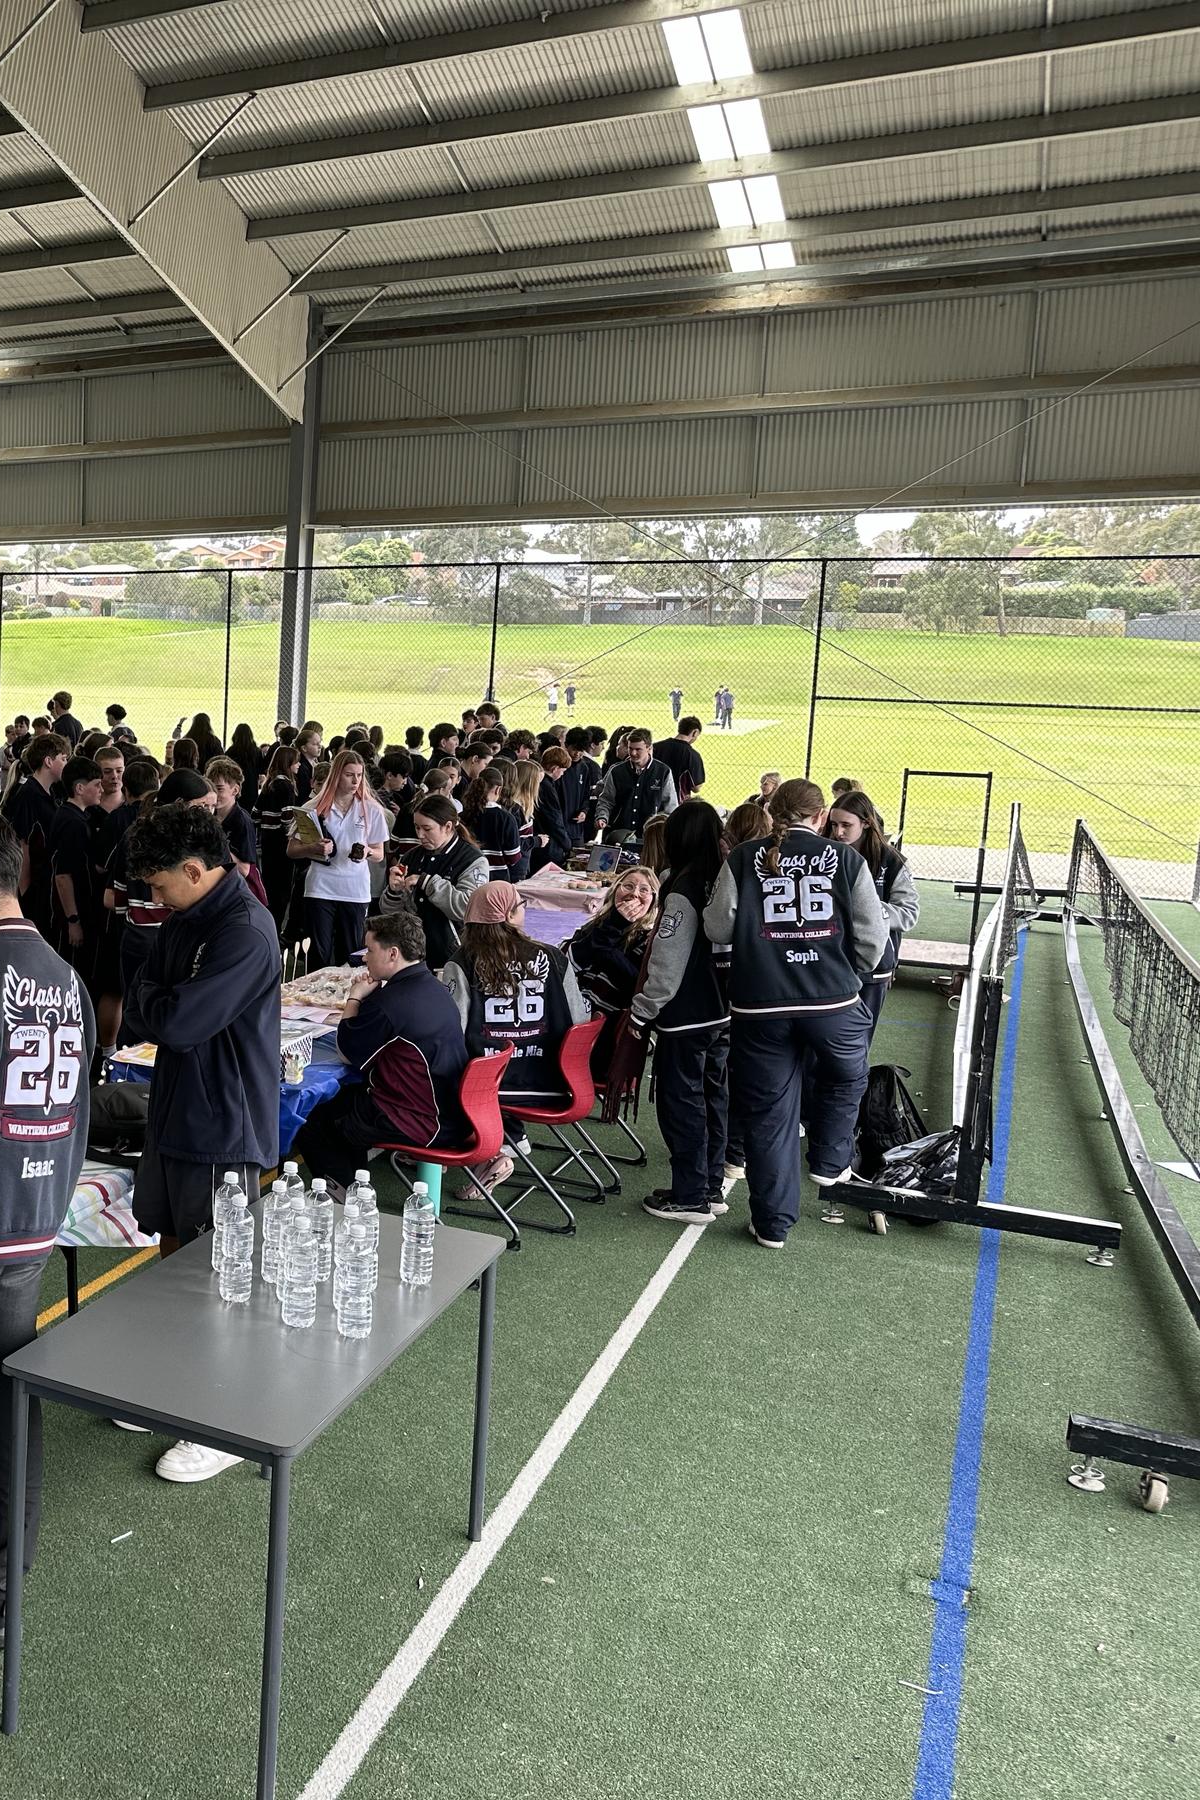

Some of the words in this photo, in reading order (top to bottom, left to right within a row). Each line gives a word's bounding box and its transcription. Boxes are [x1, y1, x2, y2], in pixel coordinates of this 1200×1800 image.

[811, 851, 829, 873] of
[762, 875, 834, 923] 26
[804, 929, 832, 939] COLLEGE
[786, 949, 819, 965] Soph
[15, 977, 62, 1007] Class
[65, 982, 78, 1020] of
[484, 979, 545, 1023] 26
[14, 1028, 48, 1039] TWENTY
[526, 1045, 543, 1057] Mia
[3, 1024, 83, 1106] 26
[8, 1123, 48, 1136] WANTIRNA
[21, 1156, 55, 1179] Isaac
